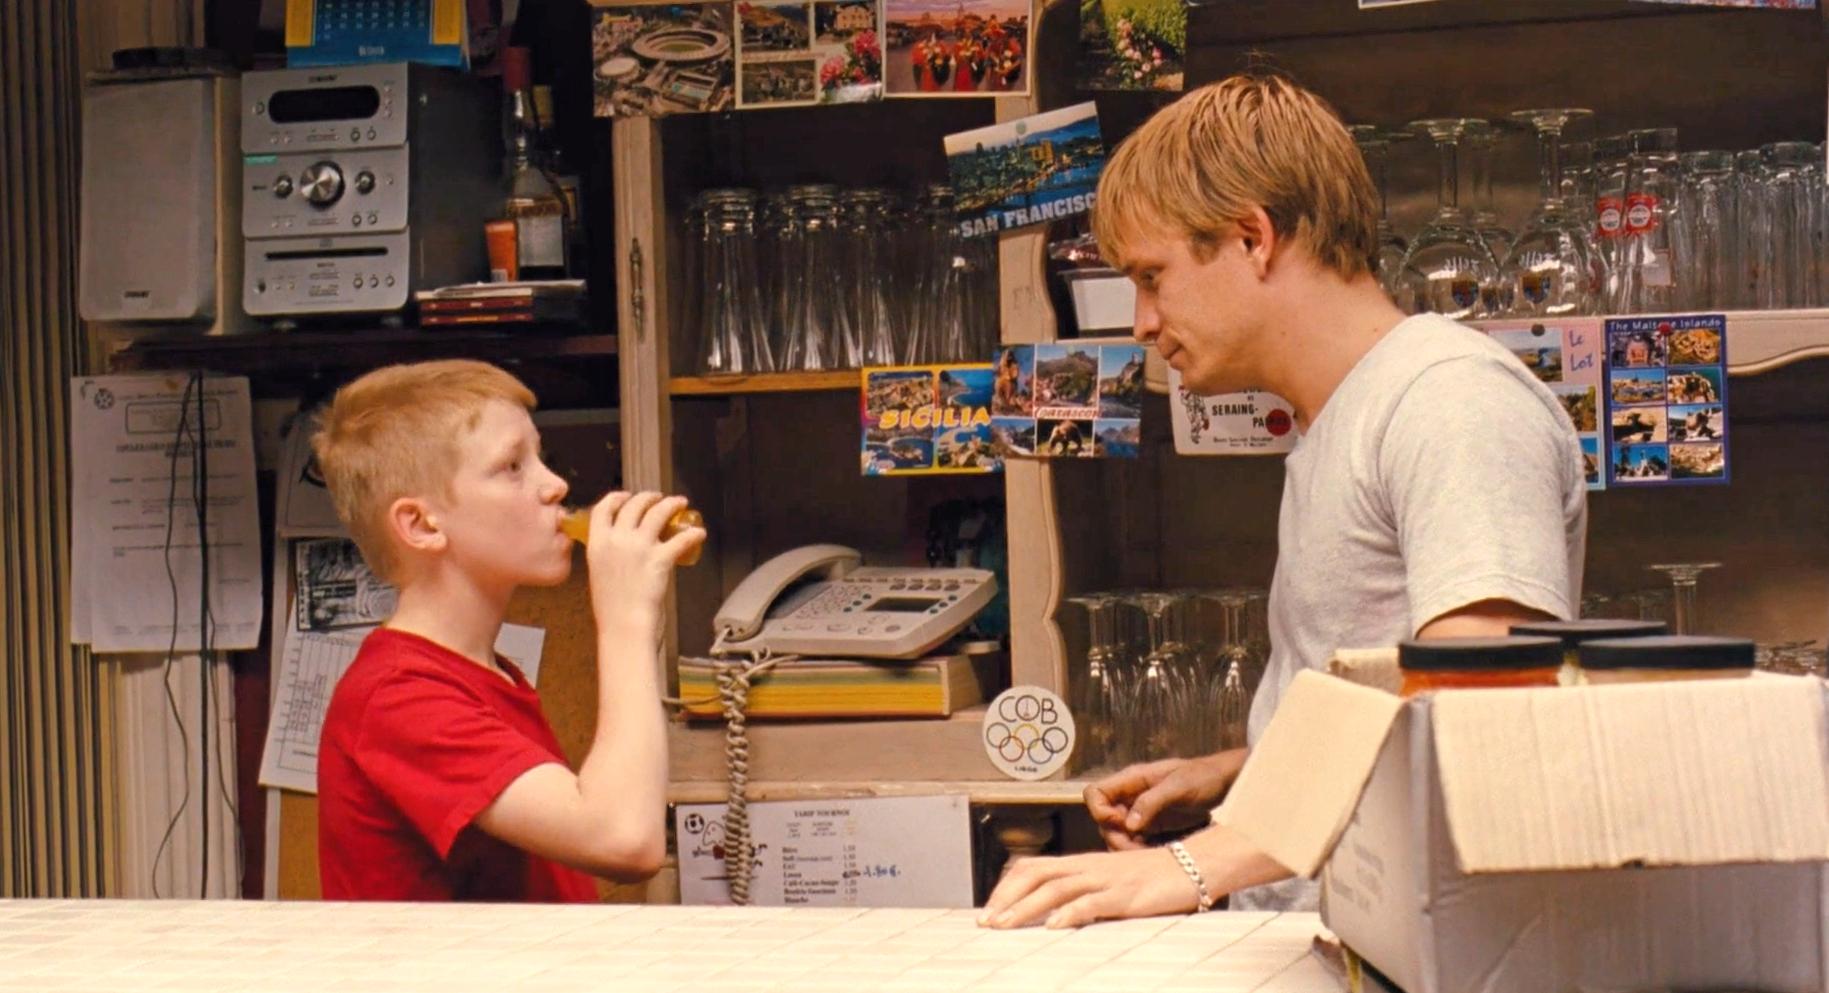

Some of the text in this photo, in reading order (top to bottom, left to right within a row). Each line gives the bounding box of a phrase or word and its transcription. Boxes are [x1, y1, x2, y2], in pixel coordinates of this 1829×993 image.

[960, 192, 1097, 238] SAN FRANCISC
[1610, 321, 1628, 331] The
[1680, 318, 1721, 328] Islands
[1569, 330, 1584, 347] Le
[879, 405, 992, 430] SICILIA
[1212, 404, 1258, 416] SERAING-
[999, 695, 1058, 724] COB
